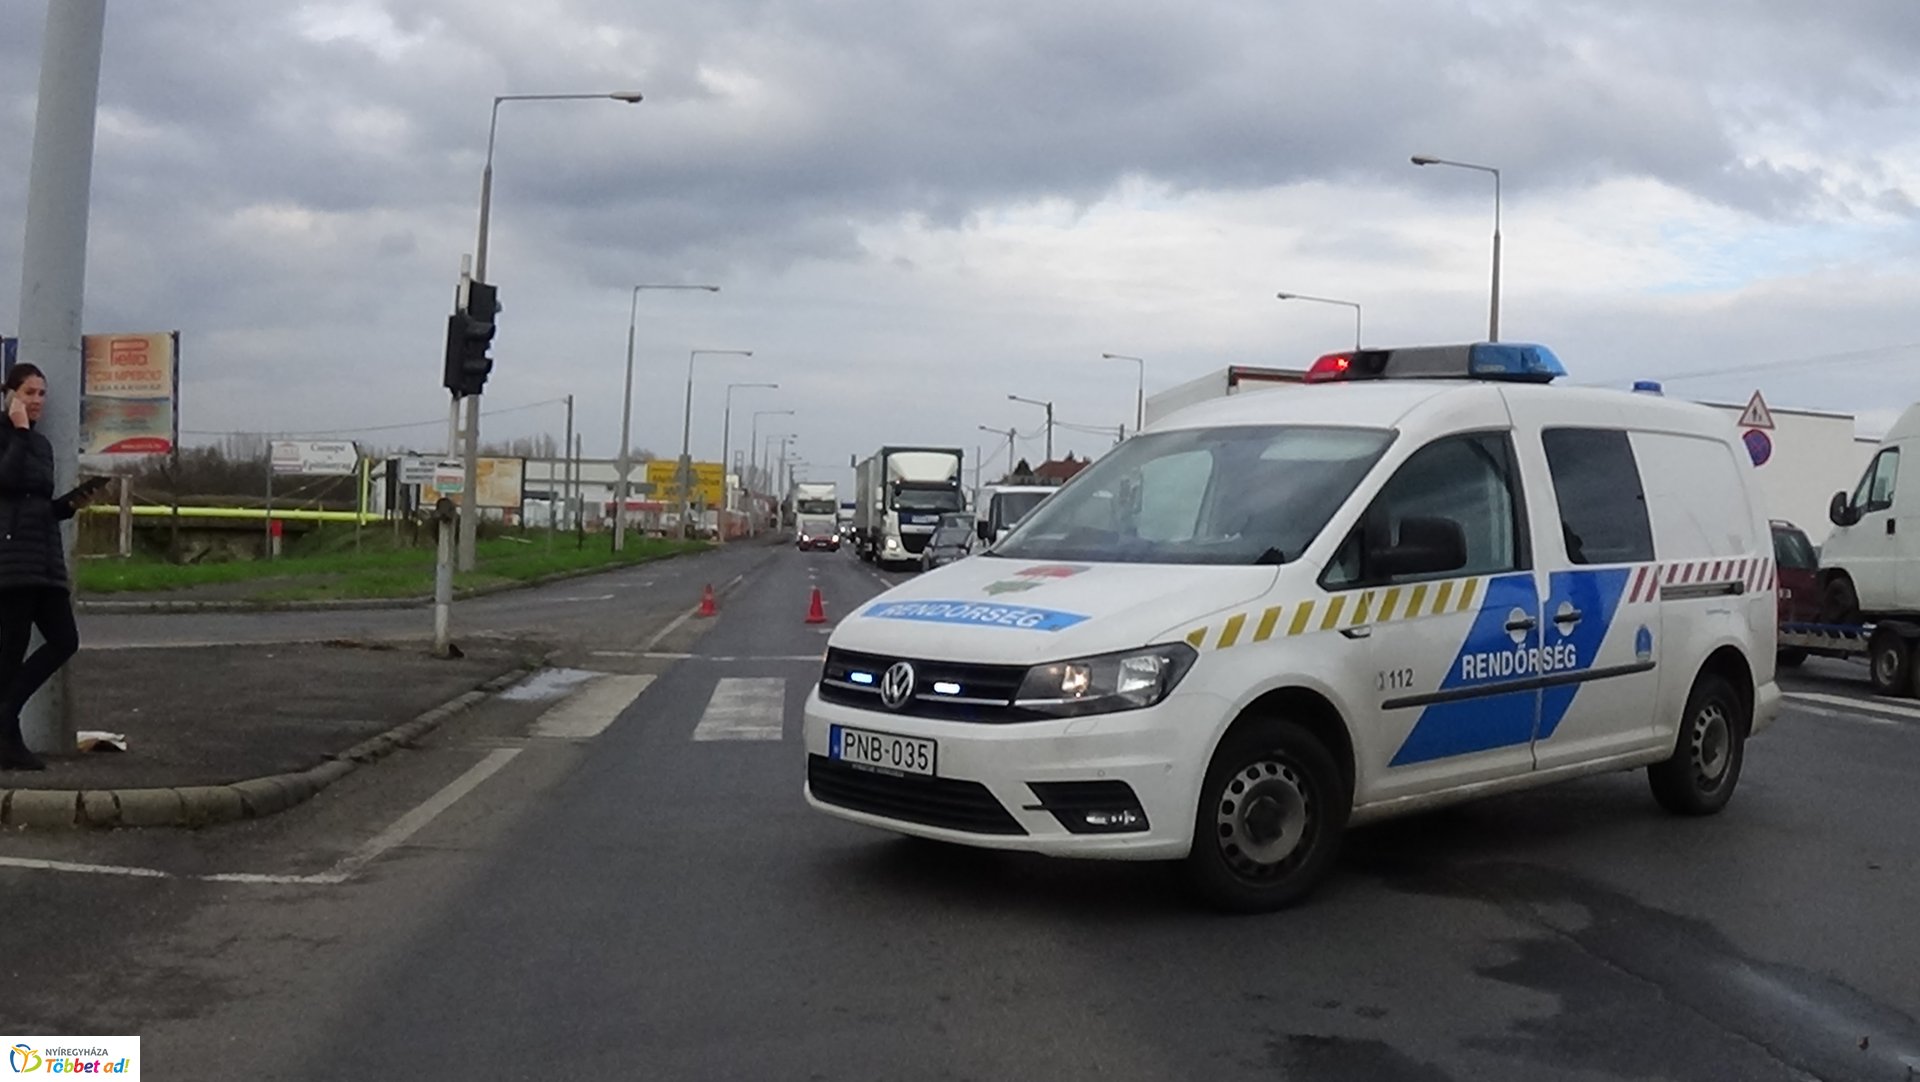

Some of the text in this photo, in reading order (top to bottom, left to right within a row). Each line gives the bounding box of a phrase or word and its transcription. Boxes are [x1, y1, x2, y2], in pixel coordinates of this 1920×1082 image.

[1389, 668, 1413, 689] 112
[1462, 639, 1577, 680] RENDŐRSÉG
[844, 732, 929, 770] PNB-035
